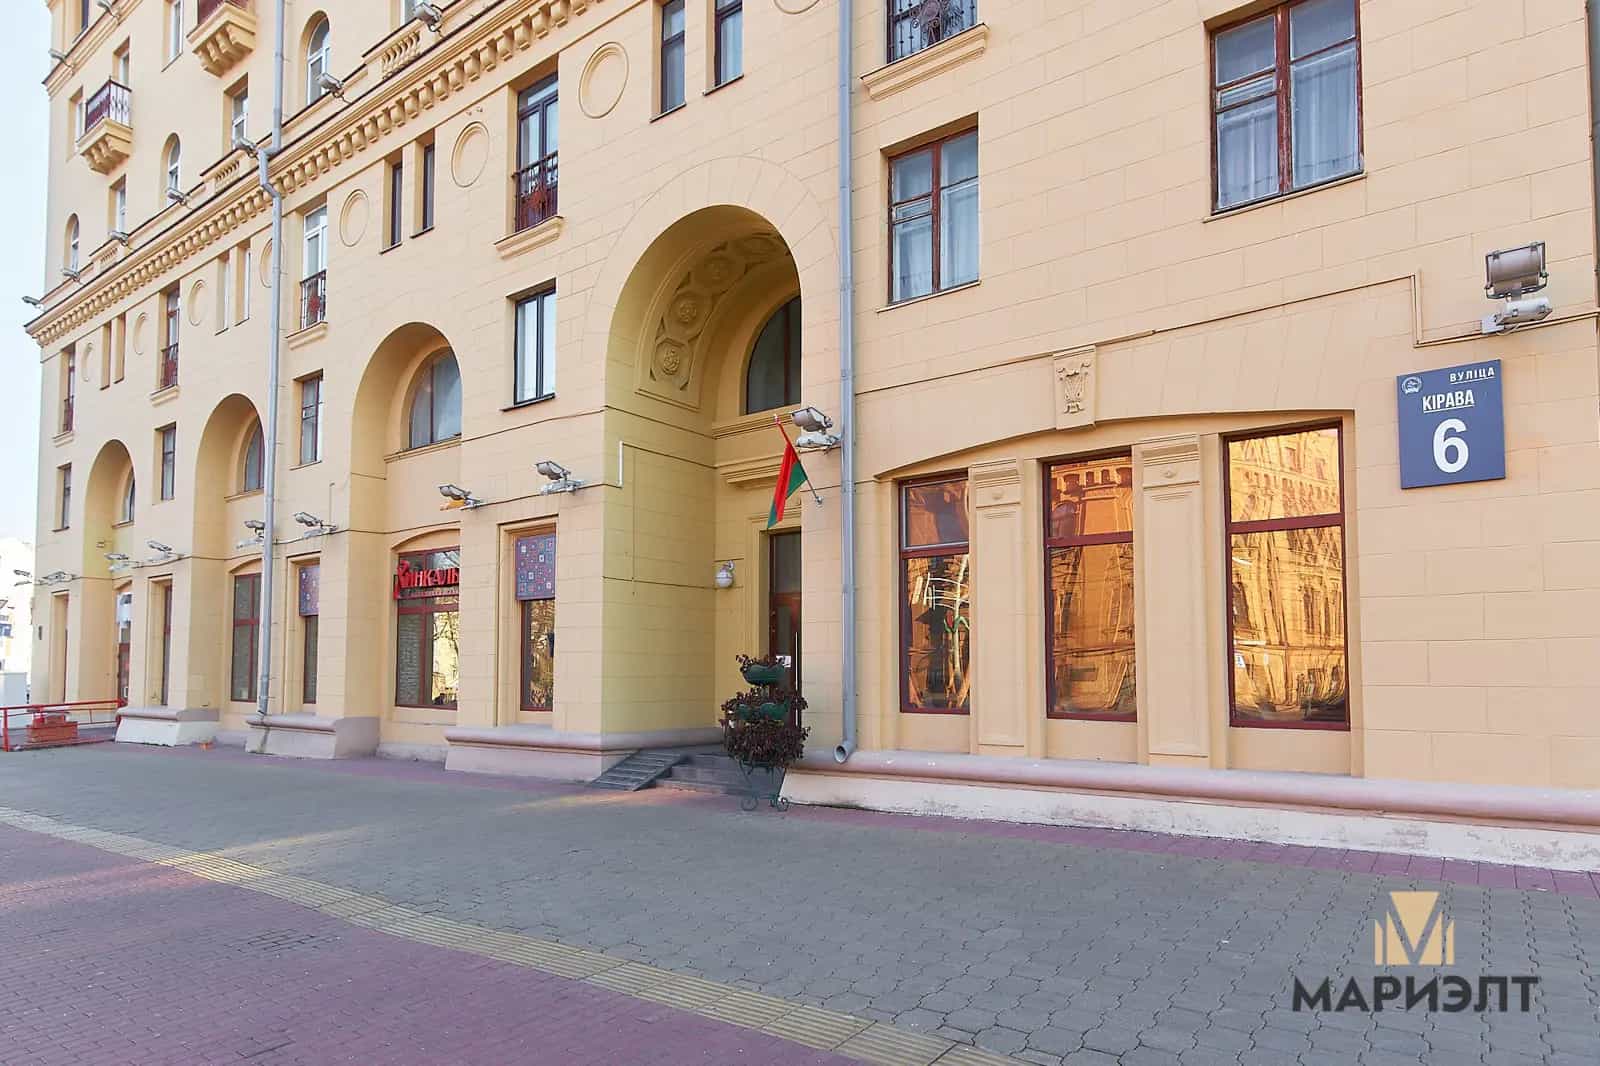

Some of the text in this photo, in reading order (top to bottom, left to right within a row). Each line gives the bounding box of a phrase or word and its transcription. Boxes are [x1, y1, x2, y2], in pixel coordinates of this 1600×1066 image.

[1449, 367, 1496, 383] ВУЛІЦА
[1422, 389, 1475, 412] КІРАВА
[1432, 418, 1469, 473] 6
